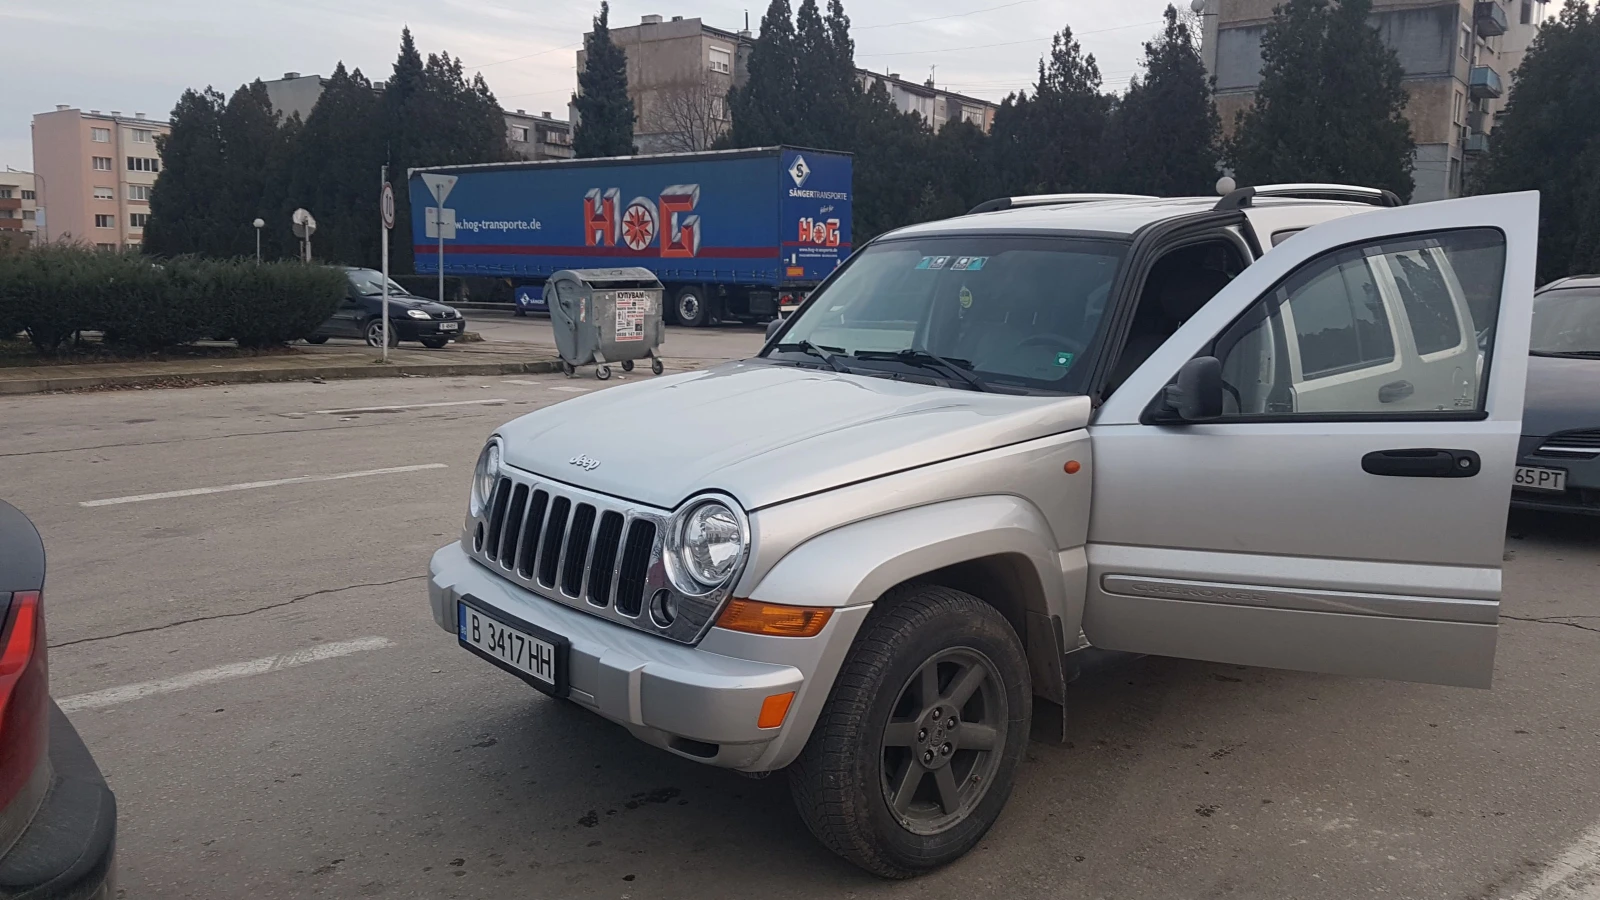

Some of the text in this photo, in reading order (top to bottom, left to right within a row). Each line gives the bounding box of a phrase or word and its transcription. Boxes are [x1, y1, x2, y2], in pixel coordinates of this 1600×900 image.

[569, 453, 601, 472] Jeep
[1514, 468, 1562, 488] 65 PT
[1131, 583, 1268, 602] CHEROKEE
[471, 613, 552, 680] B 3417 HH
